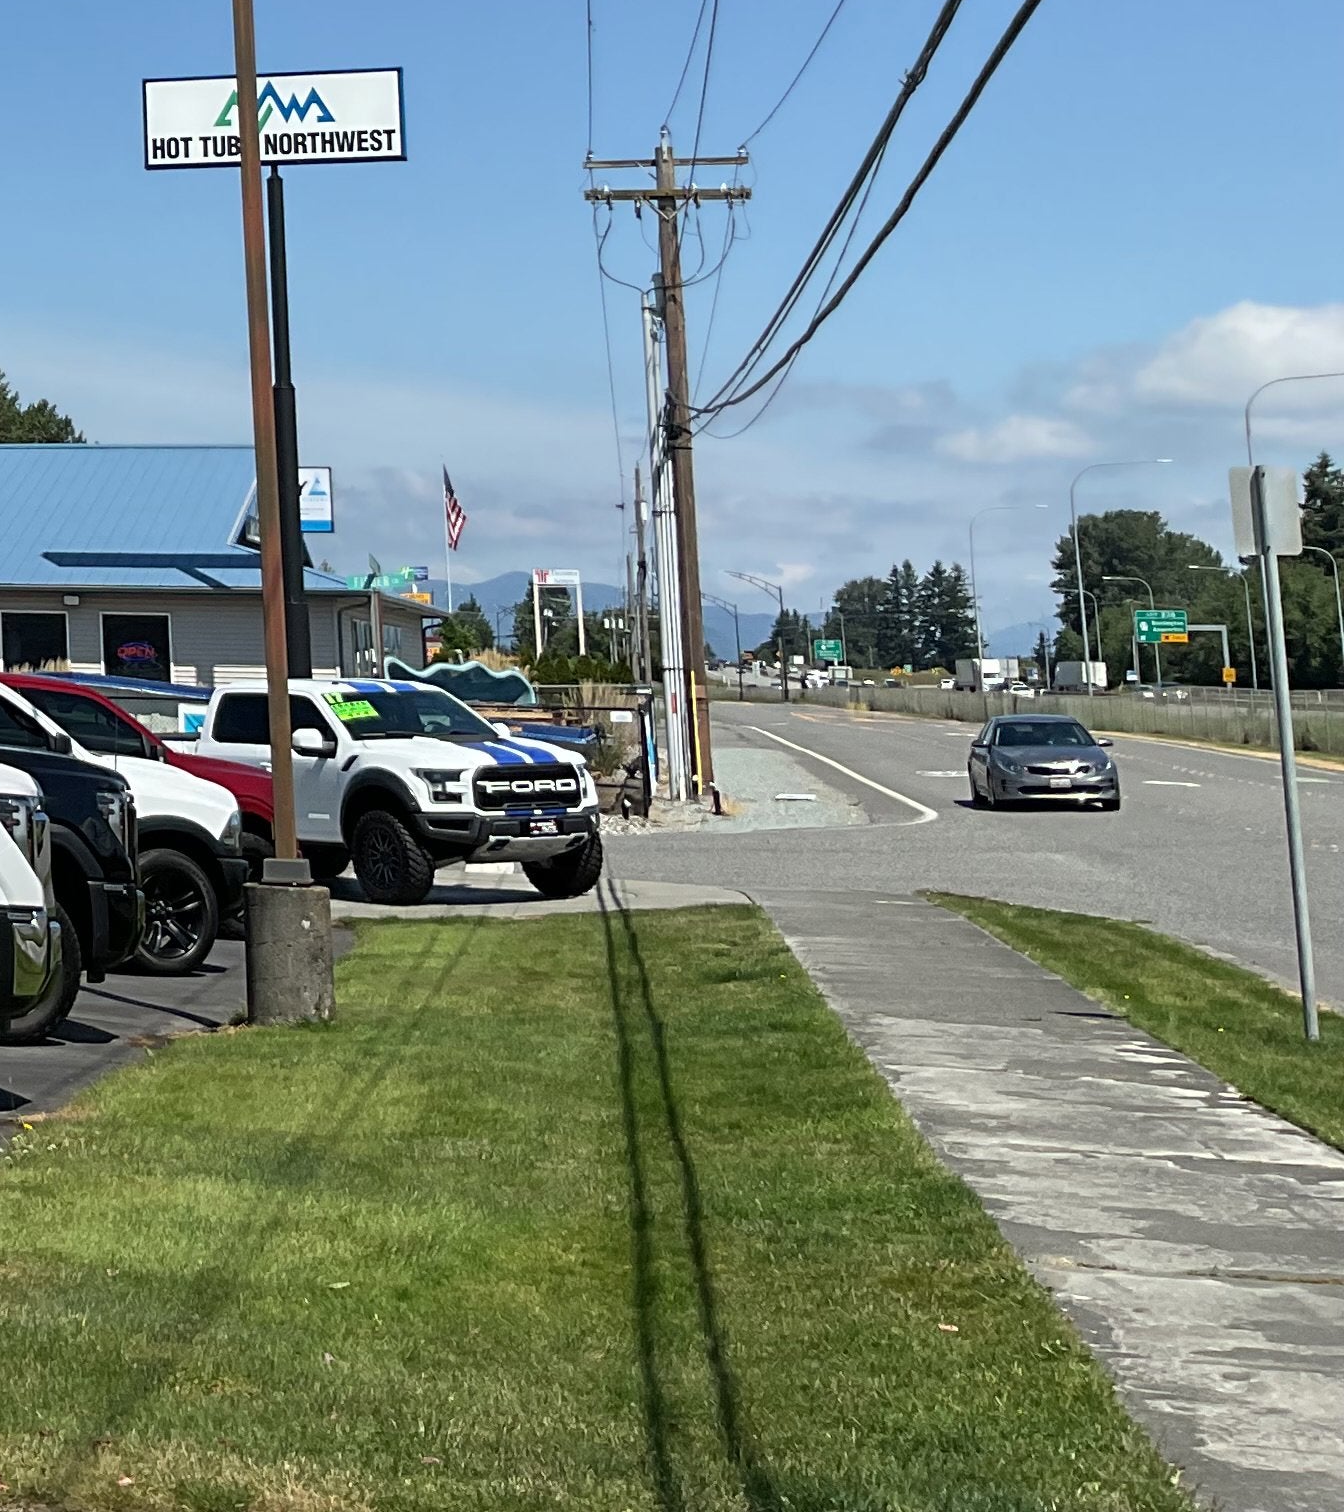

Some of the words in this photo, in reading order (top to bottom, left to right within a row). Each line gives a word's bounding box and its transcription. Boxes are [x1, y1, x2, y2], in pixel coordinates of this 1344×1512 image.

[152, 137, 192, 159] HOT
[200, 135, 242, 157] TUB
[264, 128, 396, 155] NORTHWEST
[117, 646, 155, 658] OPEN
[476, 779, 577, 794] FORD
